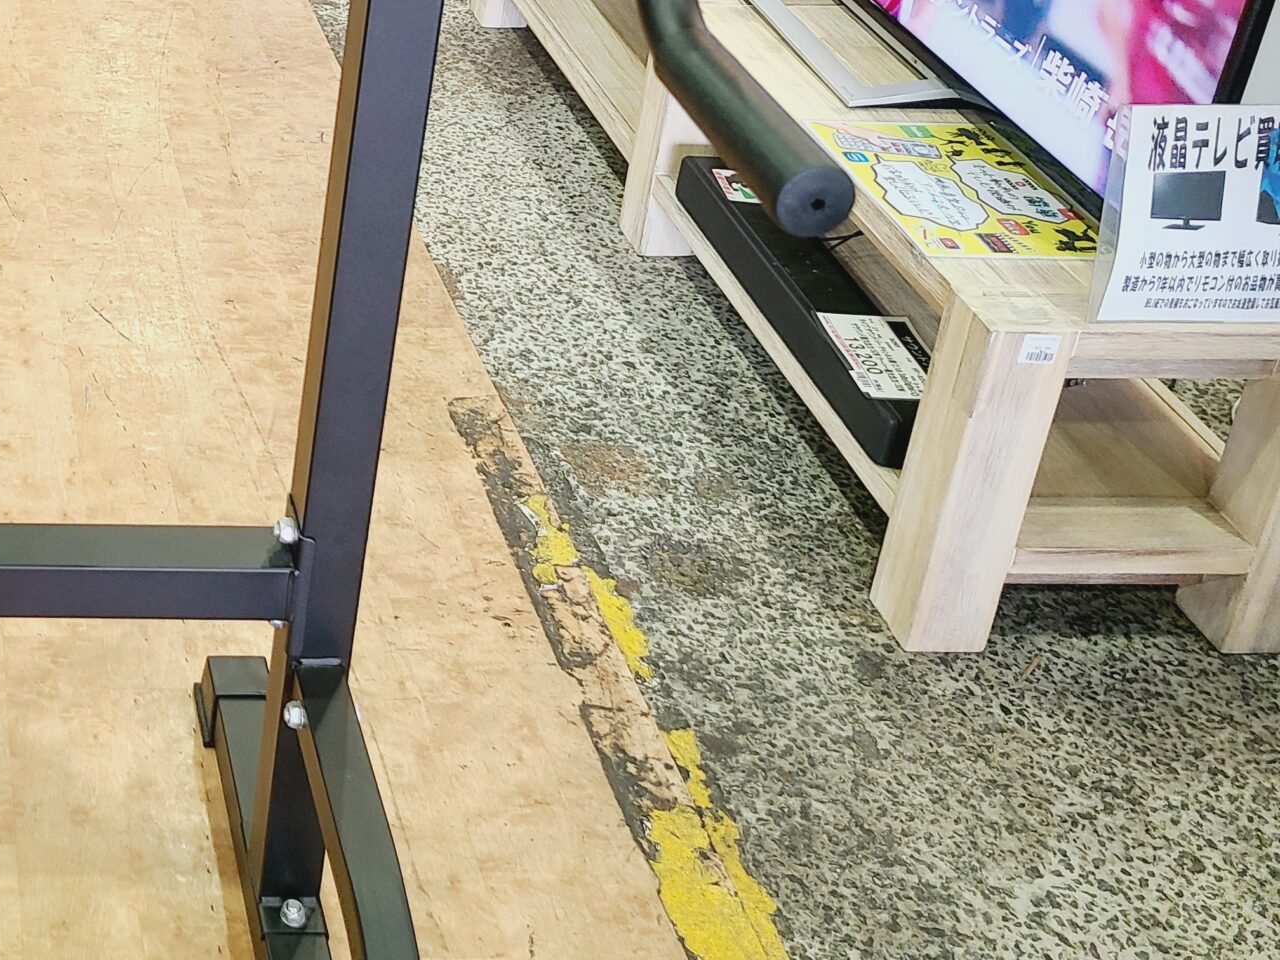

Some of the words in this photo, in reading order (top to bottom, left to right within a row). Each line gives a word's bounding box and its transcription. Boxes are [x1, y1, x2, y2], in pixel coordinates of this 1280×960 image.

[1040, 50, 1110, 121] 柴崎
[1148, 115, 1280, 171] 液晶テレビ買
[844, 338, 883, 375] 13,200
